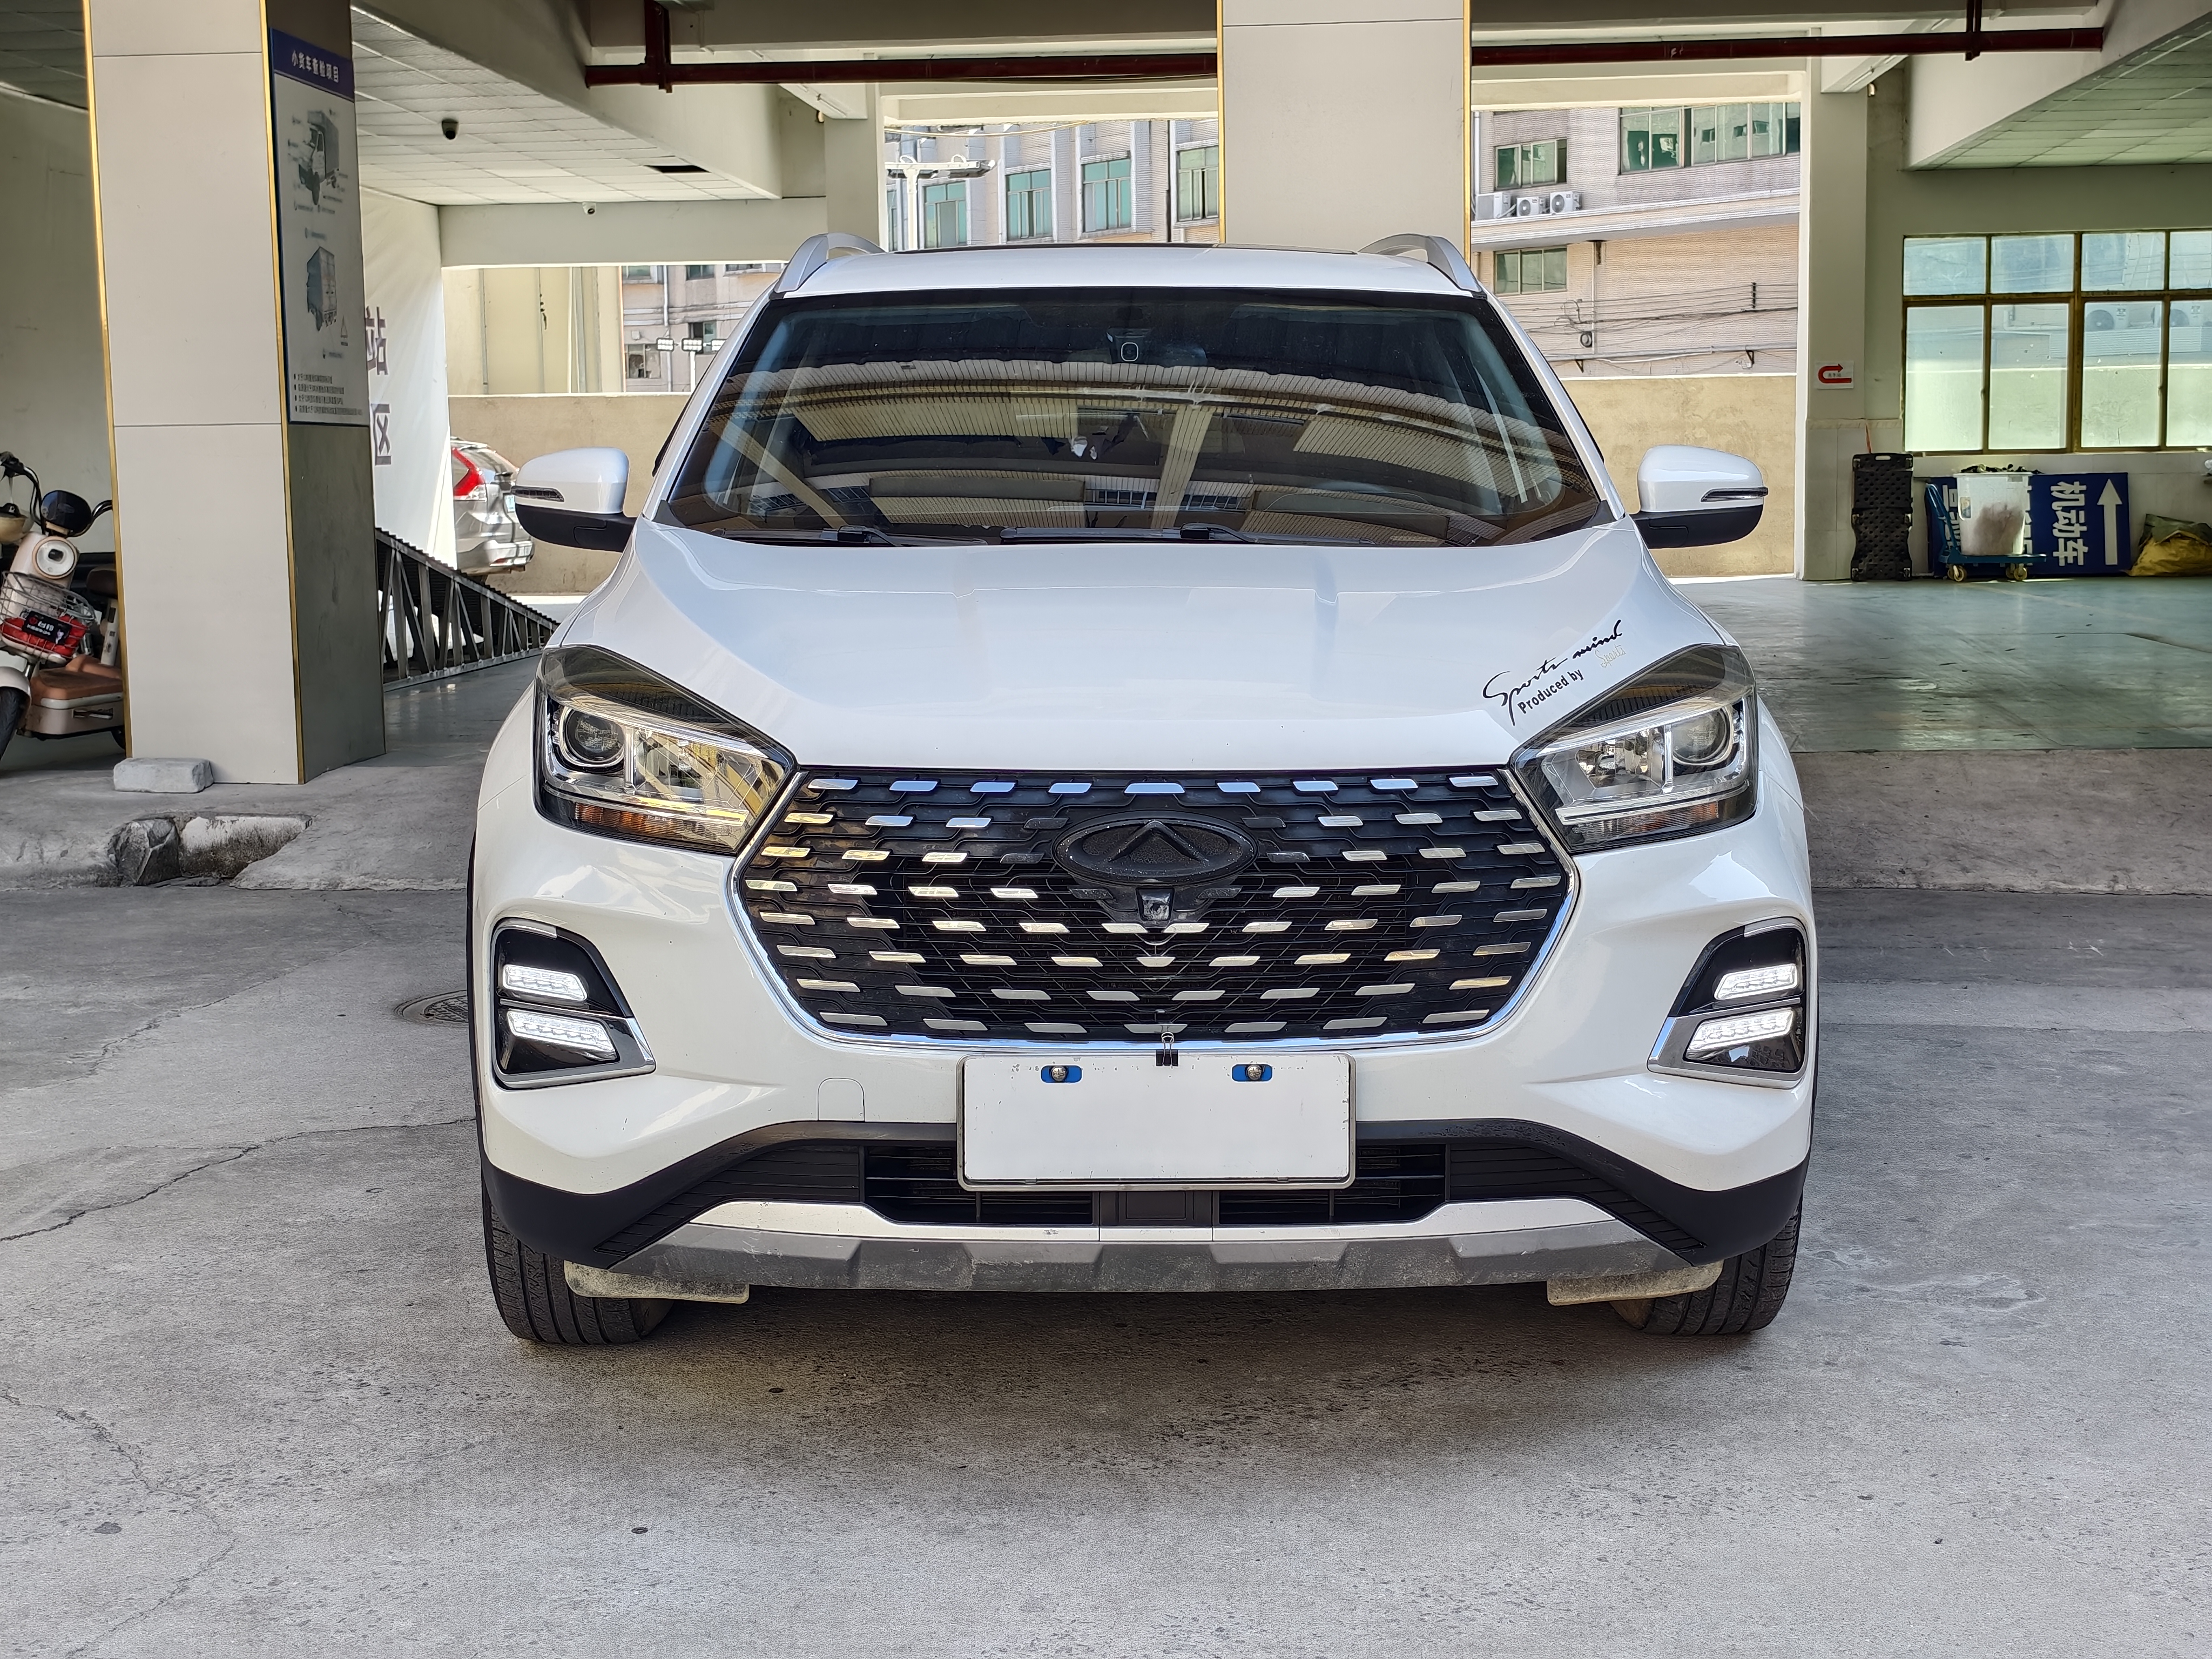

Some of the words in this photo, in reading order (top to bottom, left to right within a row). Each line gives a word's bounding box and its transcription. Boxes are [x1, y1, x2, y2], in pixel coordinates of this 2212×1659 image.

[370, 403, 392, 466] 区
[2050, 481, 2088, 566] 机动车
[1482, 657, 1568, 726] Sports
[1572, 619, 1623, 659] mind
[1517, 675, 1569, 714] Produced
[1567, 669, 1584, 682] by
[1595, 644, 1627, 668] Sports
